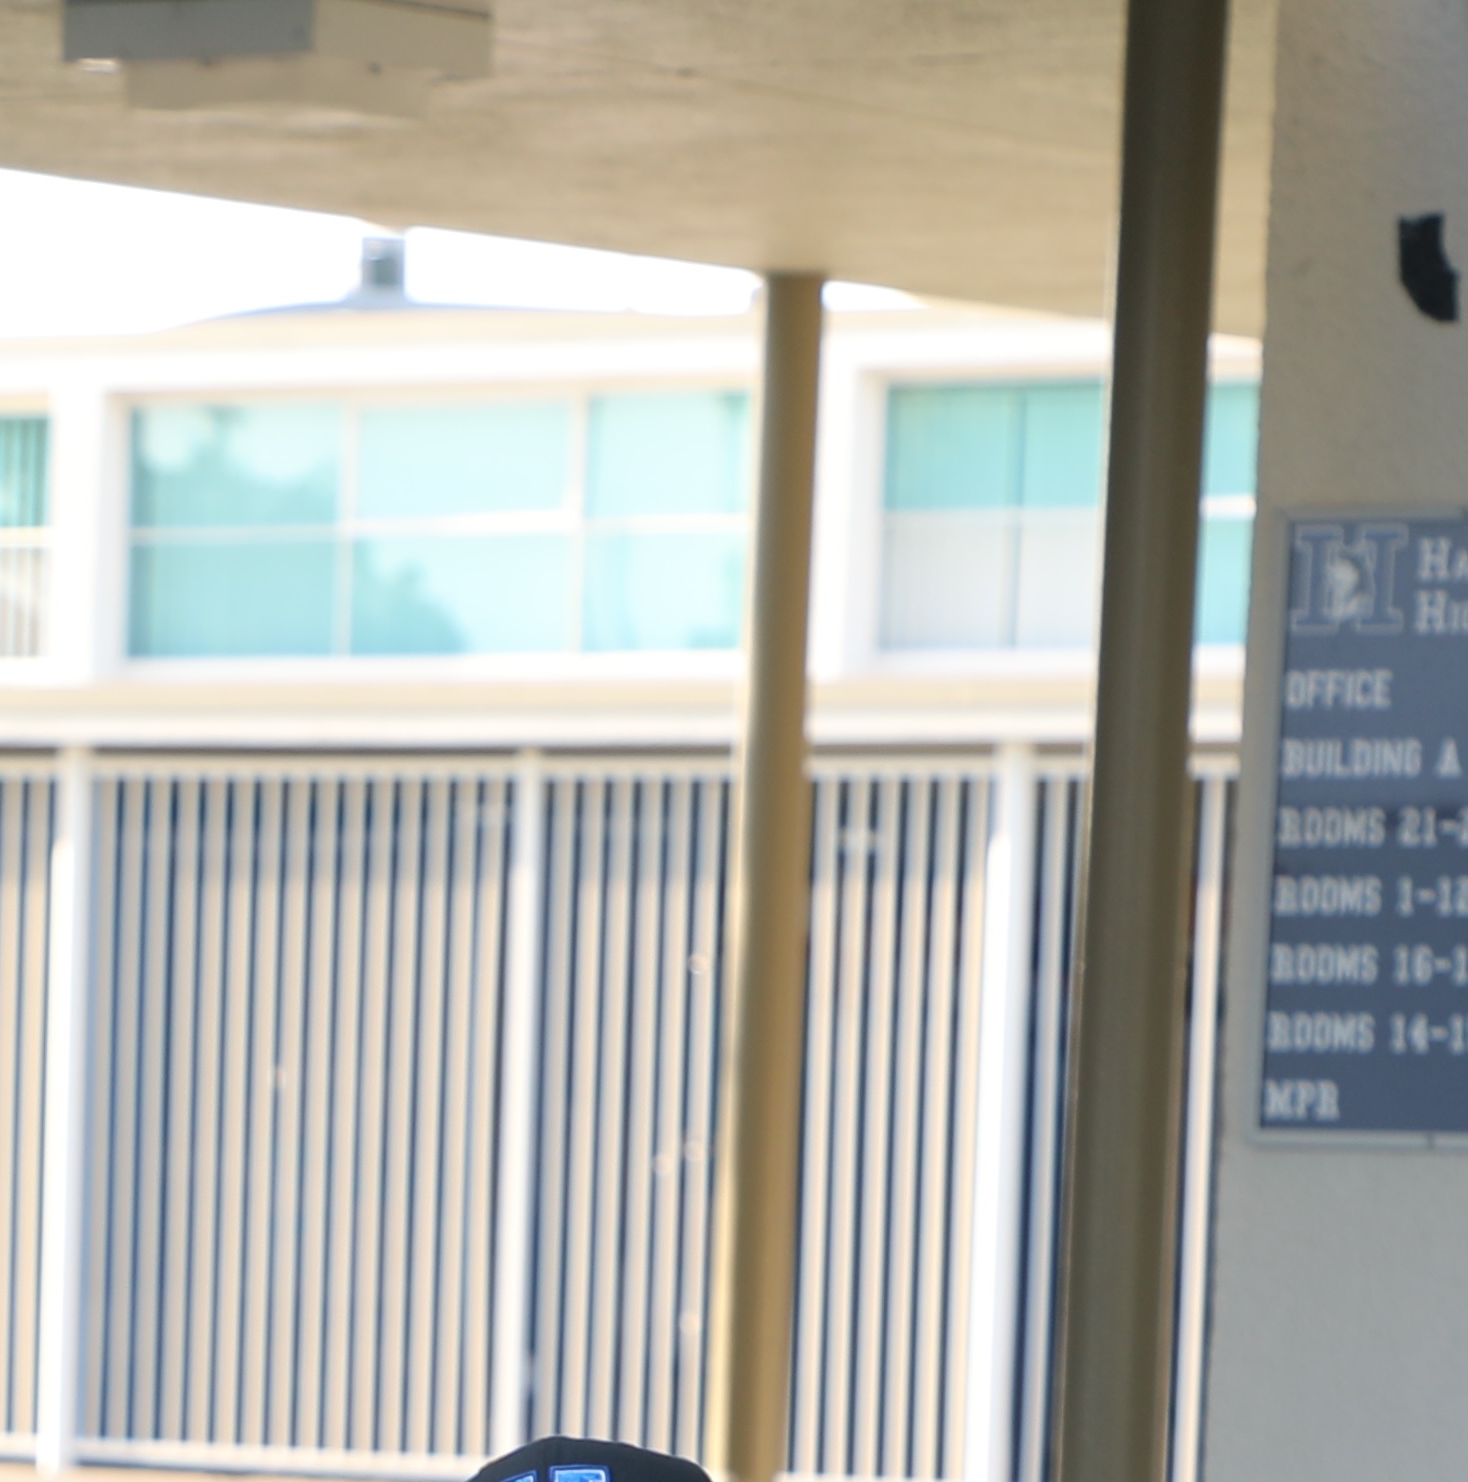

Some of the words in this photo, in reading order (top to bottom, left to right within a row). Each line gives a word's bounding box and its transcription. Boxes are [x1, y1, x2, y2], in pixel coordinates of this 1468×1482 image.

[1284, 668, 1393, 710] OFFICE
[1281, 736, 1422, 778] BUILDING
[1435, 737, 1462, 779] A
[1277, 806, 1387, 848] ROOMS
[1273, 874, 1383, 916] ROOMS
[1270, 943, 1379, 985] ROOMS
[1266, 1011, 1376, 1053] ROOMS
[1263, 1078, 1340, 1120] MPR
